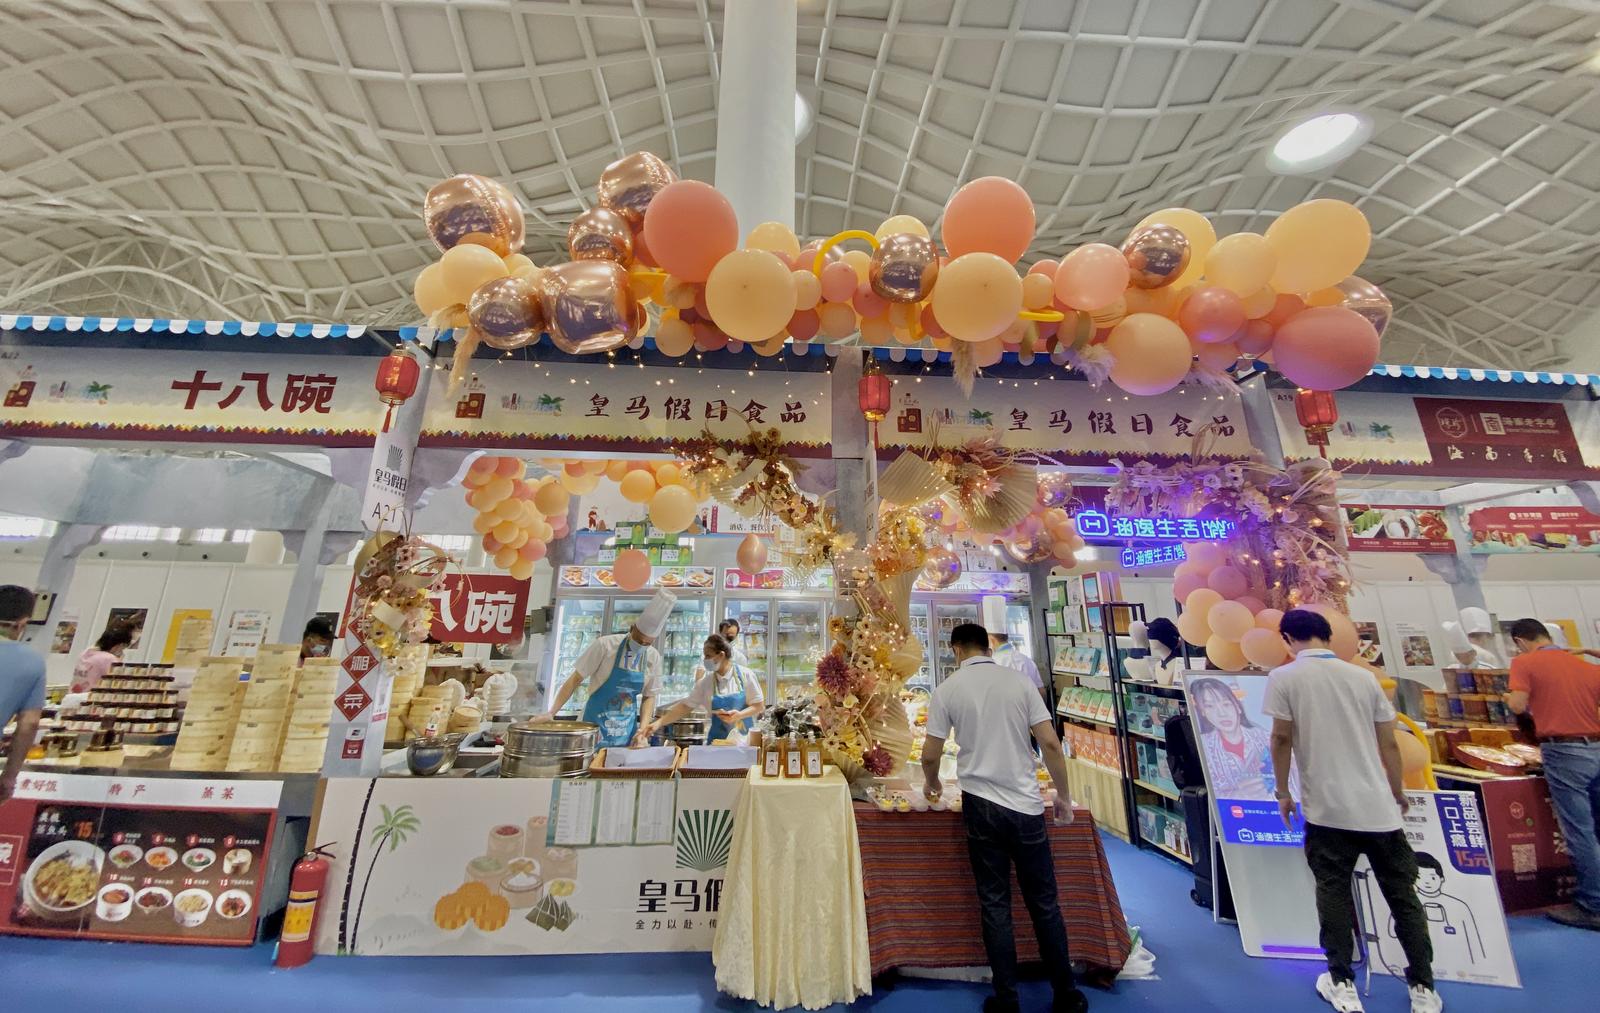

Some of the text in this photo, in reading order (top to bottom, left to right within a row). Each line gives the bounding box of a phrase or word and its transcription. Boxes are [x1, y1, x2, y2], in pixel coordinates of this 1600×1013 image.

[170, 370, 338, 414] 十八碗
[585, 393, 806, 424] 皇马假日食品
[1007, 407, 1235, 436] 皇马假日食品
[375, 468, 407, 491] 皇马假日
